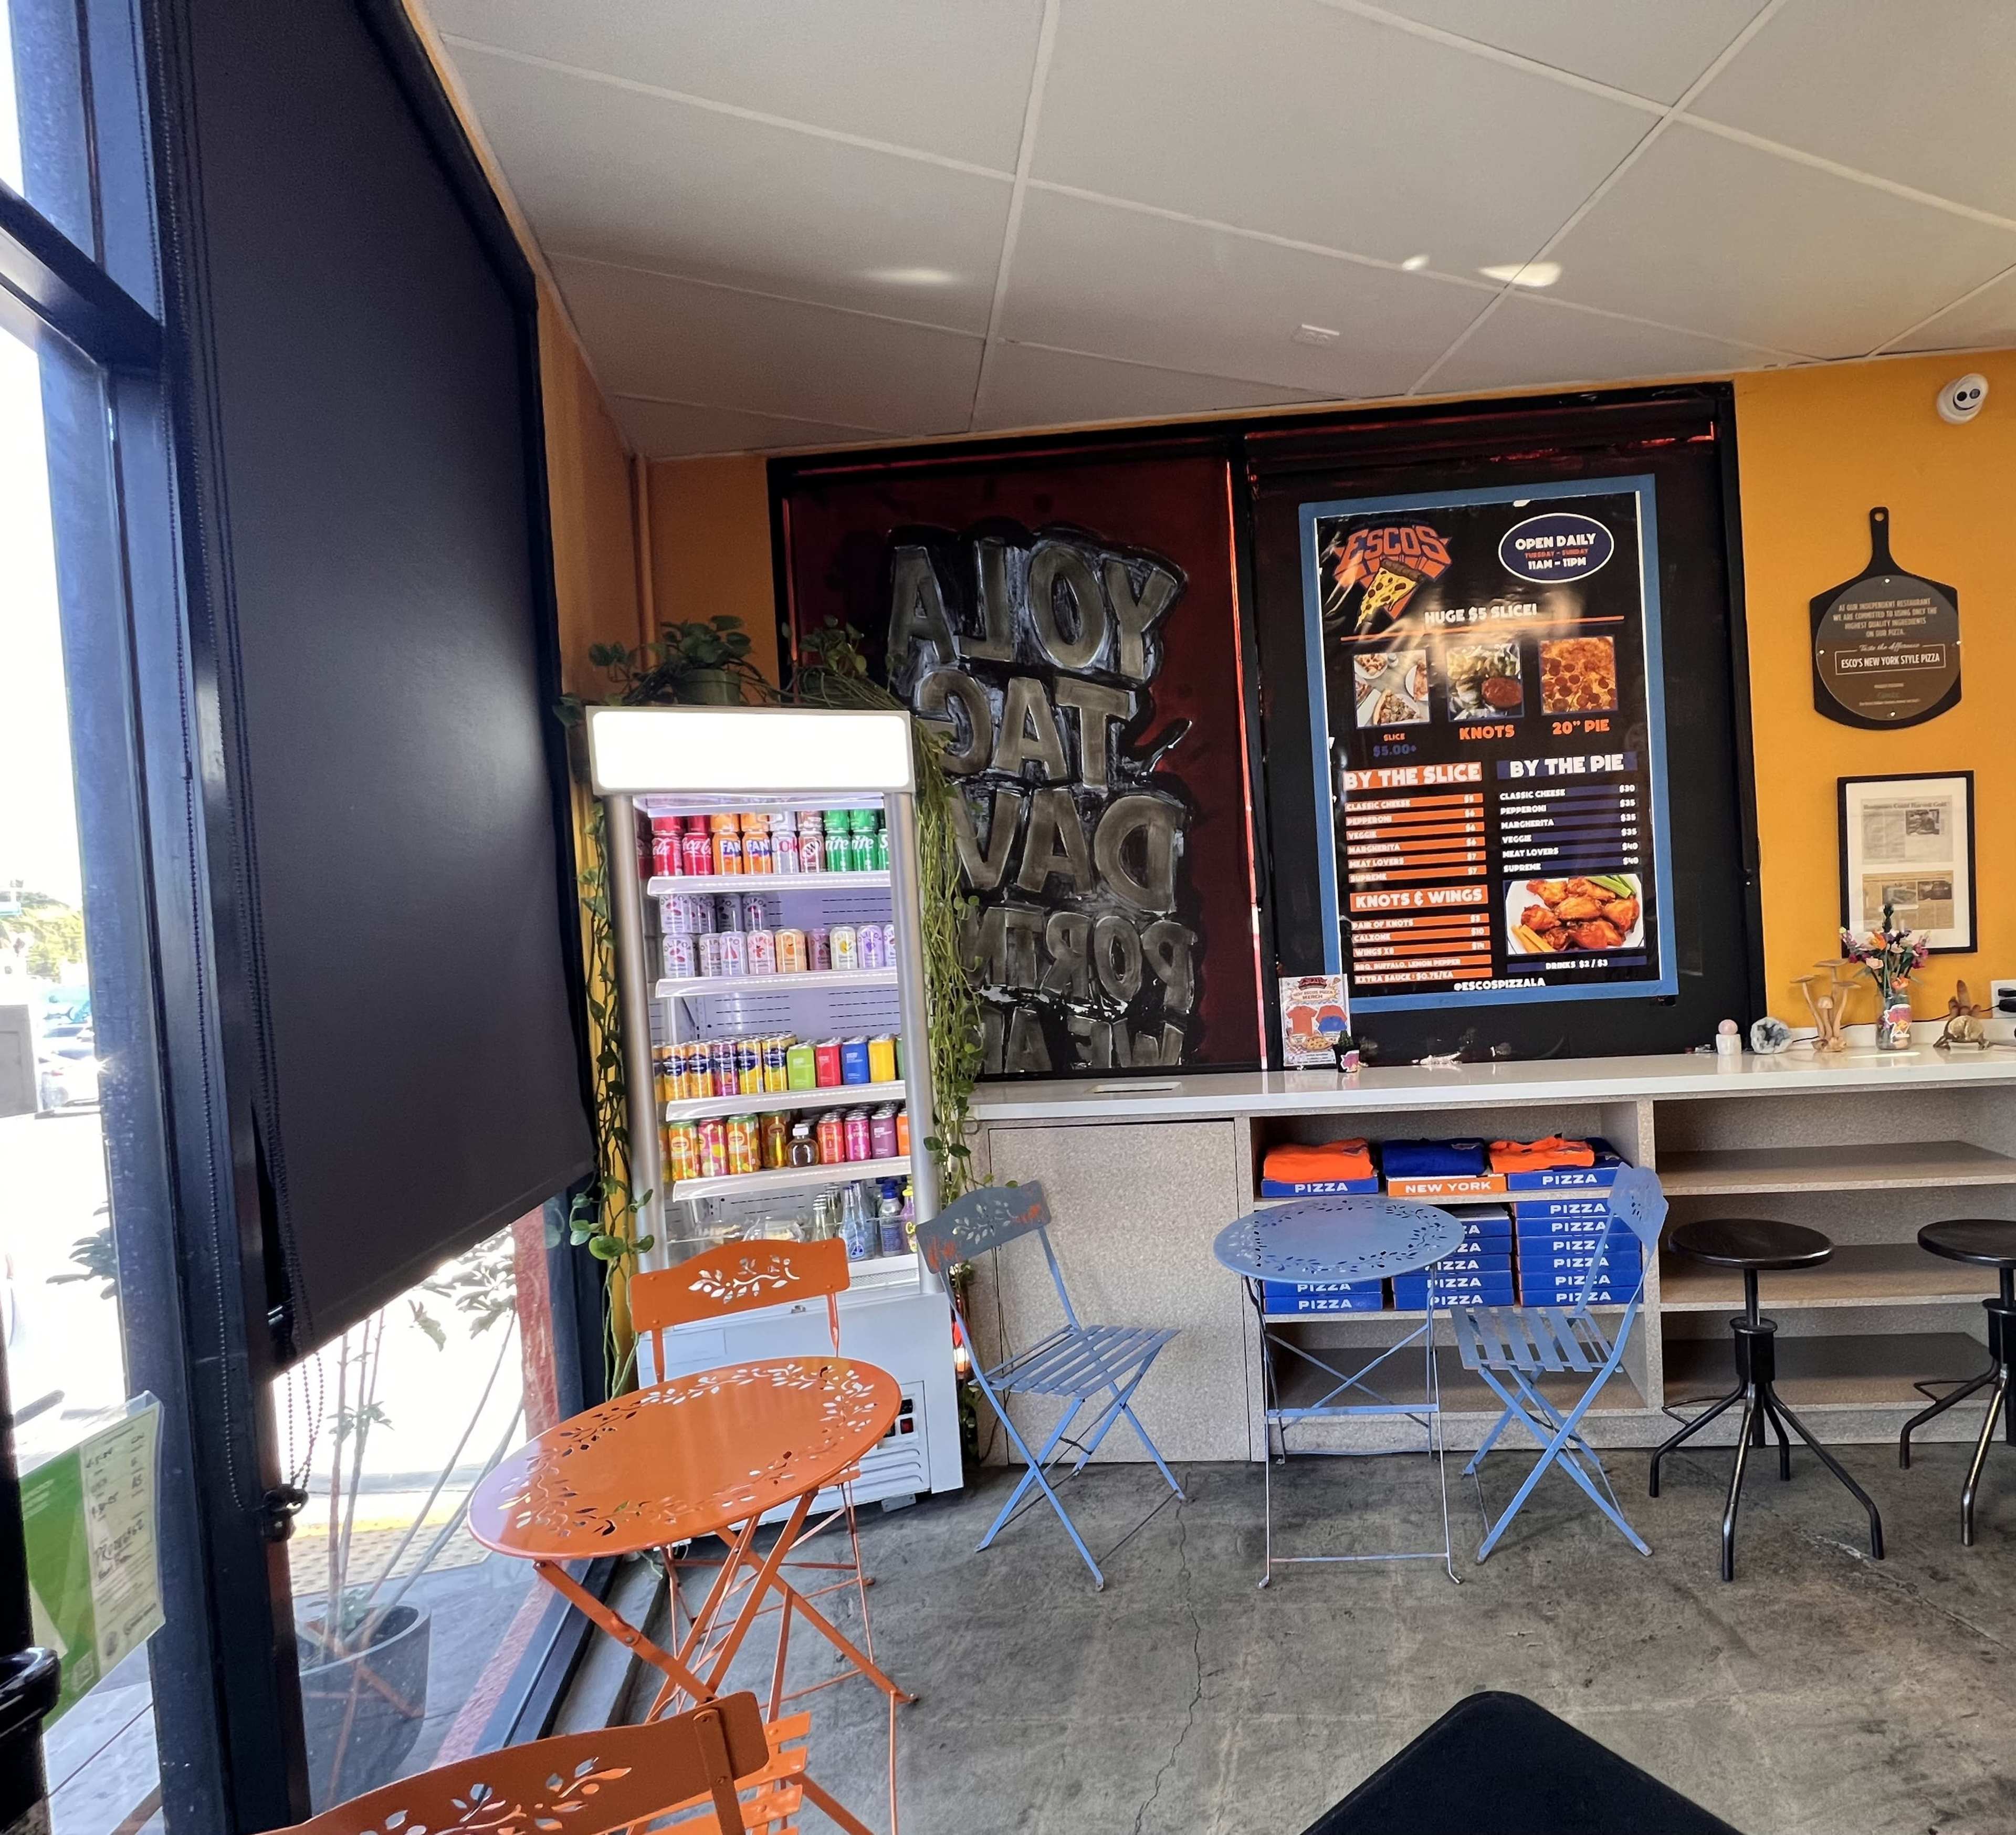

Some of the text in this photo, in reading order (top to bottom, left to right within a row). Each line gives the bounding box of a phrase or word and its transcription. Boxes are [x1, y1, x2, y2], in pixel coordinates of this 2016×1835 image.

[1516, 533, 1596, 550] OPEN DAILY
[1528, 559, 1552, 570] 11AM
[1562, 557, 1586, 567] 11PM
[1859, 601, 1895, 610] INDEPENDENT
[1897, 598, 1930, 606] RESTAURANT
[1424, 603, 1537, 624] HUGE $5 SLICE!
[1855, 611, 1885, 620] COMMITTED
[1892, 617, 1926, 626] INGREDIENTS
[1841, 653, 1940, 669] ESCO'S NEW YORK STYLE PIZZA
[1584, 719, 1610, 733] PIE
[1459, 725, 1515, 740] KNOTS
[1510, 753, 1624, 778] BY THE PIE
[1344, 763, 1480, 790] BY THE SLICE
[1500, 791, 1534, 800] CLASSIC
[1535, 789, 1566, 798] CHEESE
[1346, 801, 1379, 812] CLASSIC
[1381, 799, 1411, 809] CHEESE
[1500, 799, 1636, 815] PEPPERONI $35
[1346, 815, 1392, 826] PEPPERONI
[1501, 813, 1636, 830] MARGHERITA $35
[1348, 831, 1377, 840] VEGGIE
[1502, 828, 1637, 844] VEGGIE $35
[1348, 843, 1400, 854] MARGHERITA
[1503, 842, 1638, 858] MEAT LOVERS $40
[1349, 858, 1371, 869] MEAT
[1372, 857, 1404, 867] LOVERS
[1503, 857, 1639, 873] SUPREME $40
[1349, 873, 1387, 883] SUPREME
[1356, 888, 1482, 908] KNOTS & WINGS
[1351, 921, 1372, 930] PAIR
[1373, 920, 1384, 929] OF
[1386, 919, 1414, 928] KNOTS
[1354, 933, 1390, 942] CALZONE
[1354, 948, 1382, 957] WINGS
[1408, 960, 1432, 969] LEMON
[1433, 958, 1461, 967] PEPPER
[1546, 960, 1576, 970] DRINKS
[1579, 960, 1590, 968] $2
[1598, 959, 1608, 967] $3
[1355, 975, 1382, 984] EXTRA
[1385, 973, 1411, 982] SAUCE
[1454, 978, 1546, 991] @ESCOSPIZZALA
[1542, 1174, 1597, 1185] PIZZA
[1295, 1182, 1348, 1193] PIZZA
[1405, 1181, 1492, 1193] NEW YORK
[1550, 1203, 1606, 1214] PIZZA
[1552, 1221, 1606, 1232] PIZZA
[1553, 1240, 1609, 1251] PIZZ
[1425, 1260, 1479, 1271] IZZA
[1555, 1275, 1611, 1285] PIZA
[1297, 1283, 1351, 1292] PIZZA
[1298, 1299, 1352, 1310] PIZZA
[1430, 1295, 1483, 1305] PIZZA
